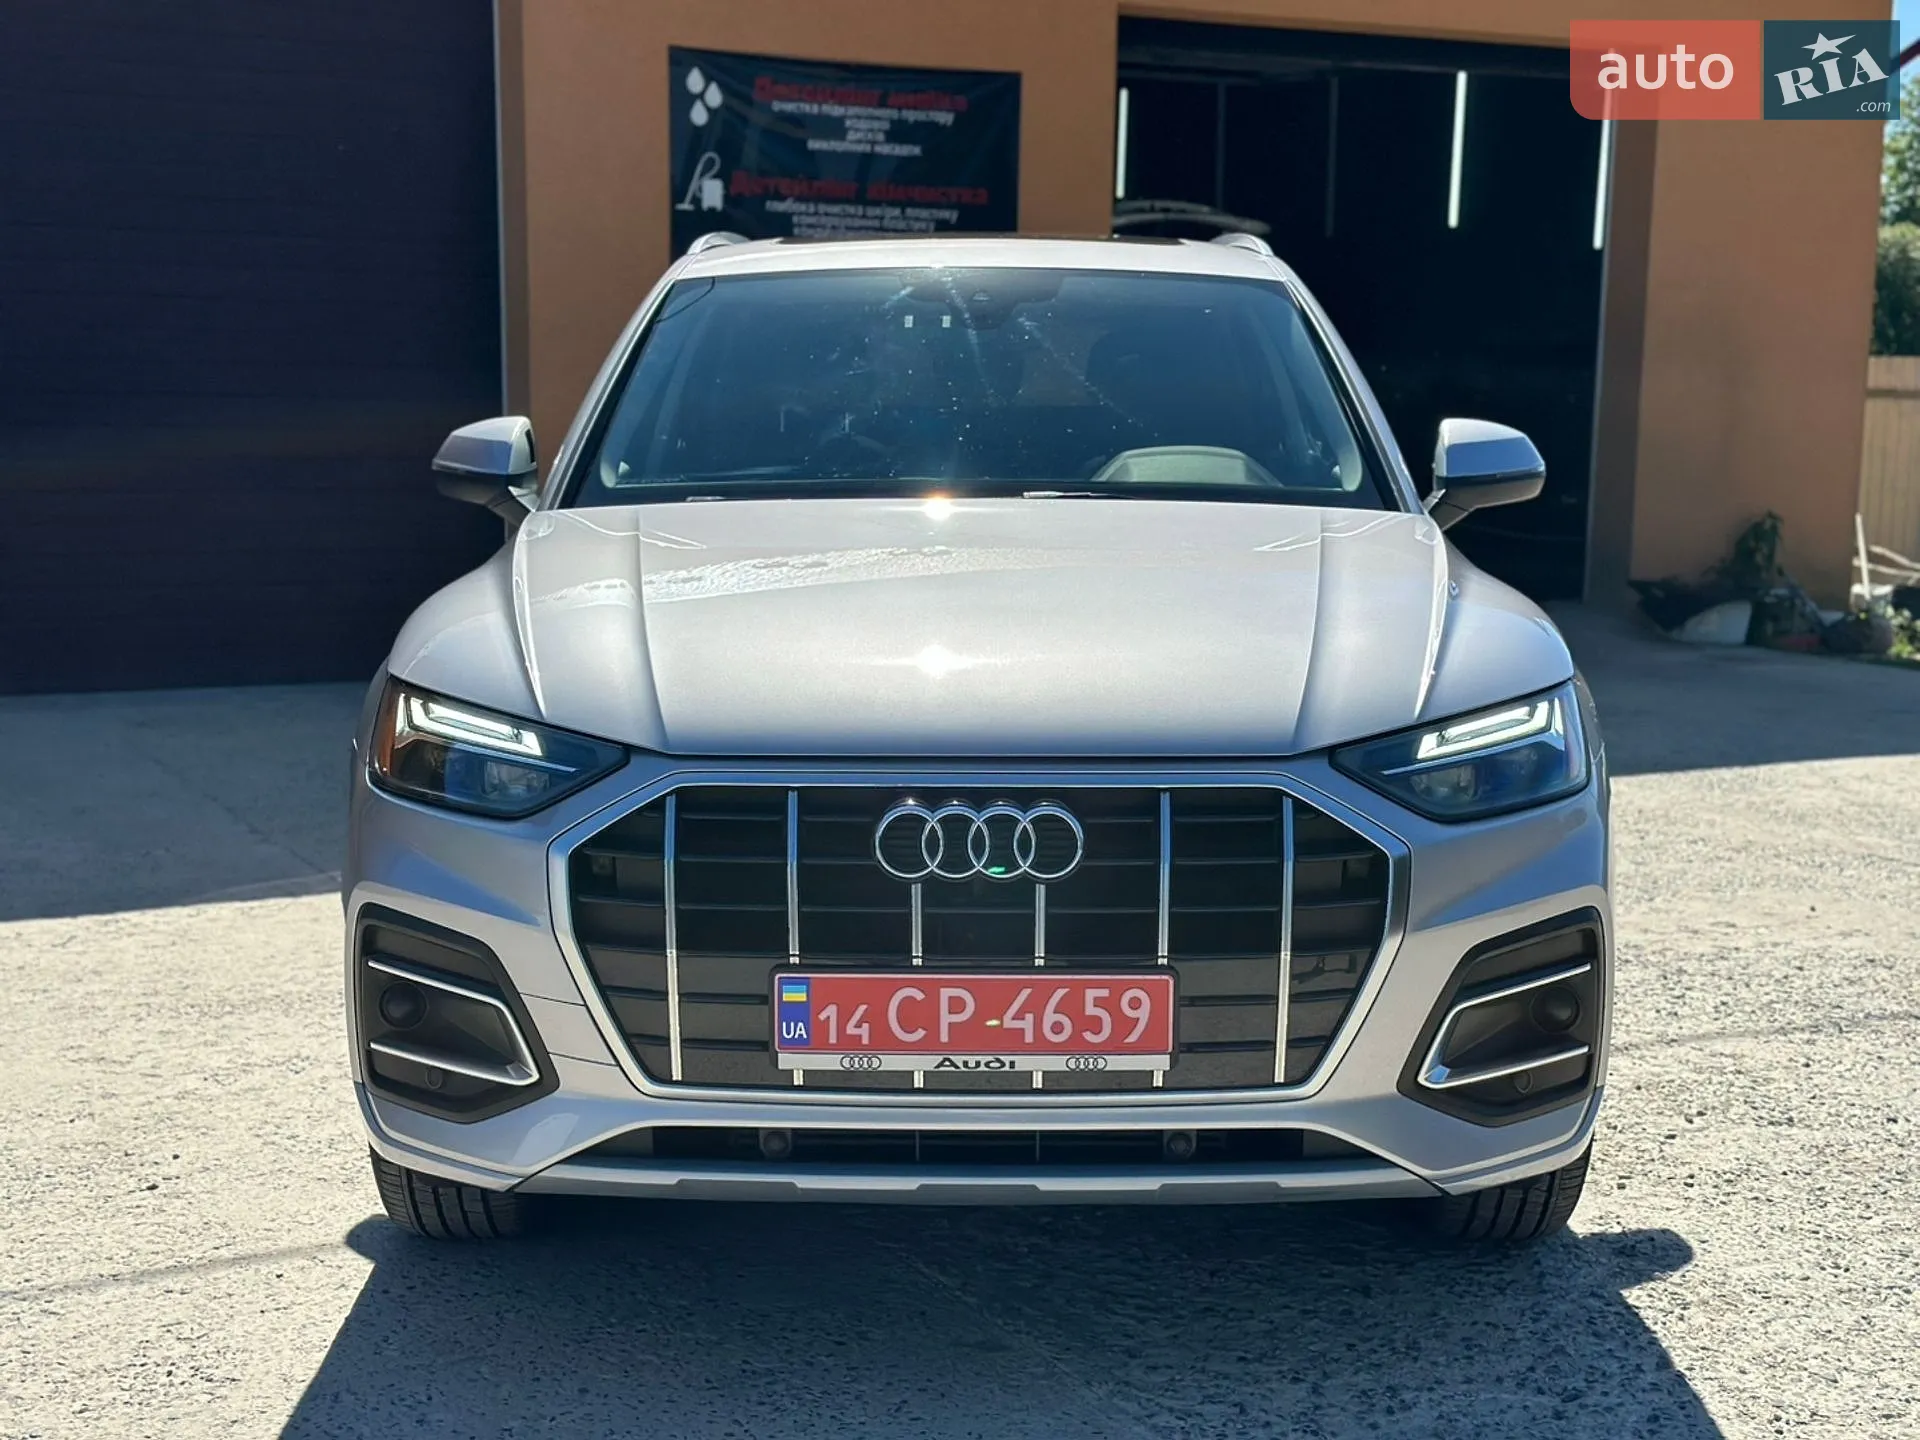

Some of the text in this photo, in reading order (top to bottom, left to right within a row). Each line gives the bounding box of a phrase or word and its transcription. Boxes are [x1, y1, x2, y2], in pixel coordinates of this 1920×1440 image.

[782, 987, 1152, 1045] UA 14 CP 4659
[933, 1056, 1016, 1071] Audi
